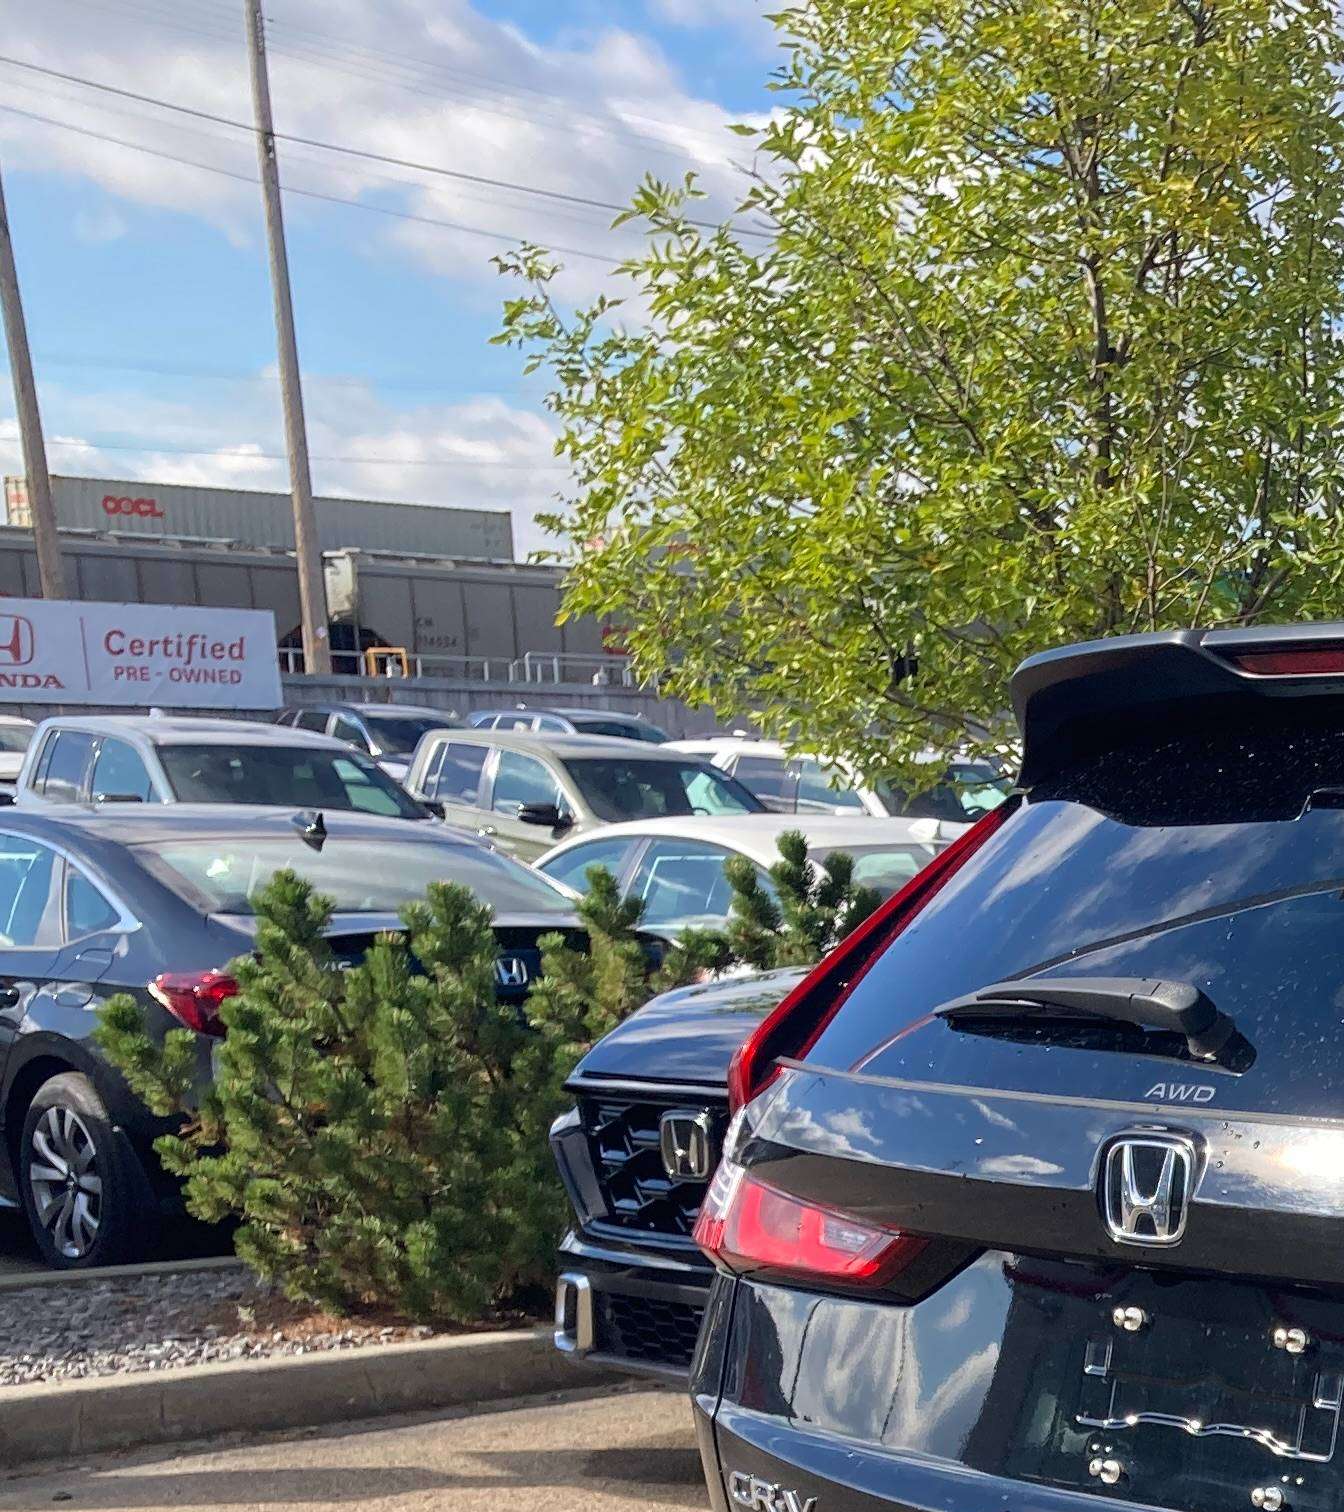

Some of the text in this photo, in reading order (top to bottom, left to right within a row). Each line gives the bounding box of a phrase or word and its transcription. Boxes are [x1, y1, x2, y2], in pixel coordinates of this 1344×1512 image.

[104, 629, 245, 666] Certified
[0, 673, 66, 689] NDA
[113, 666, 150, 682] PRE
[168, 667, 242, 685] OWNED
[1144, 1082, 1217, 1102] AWD
